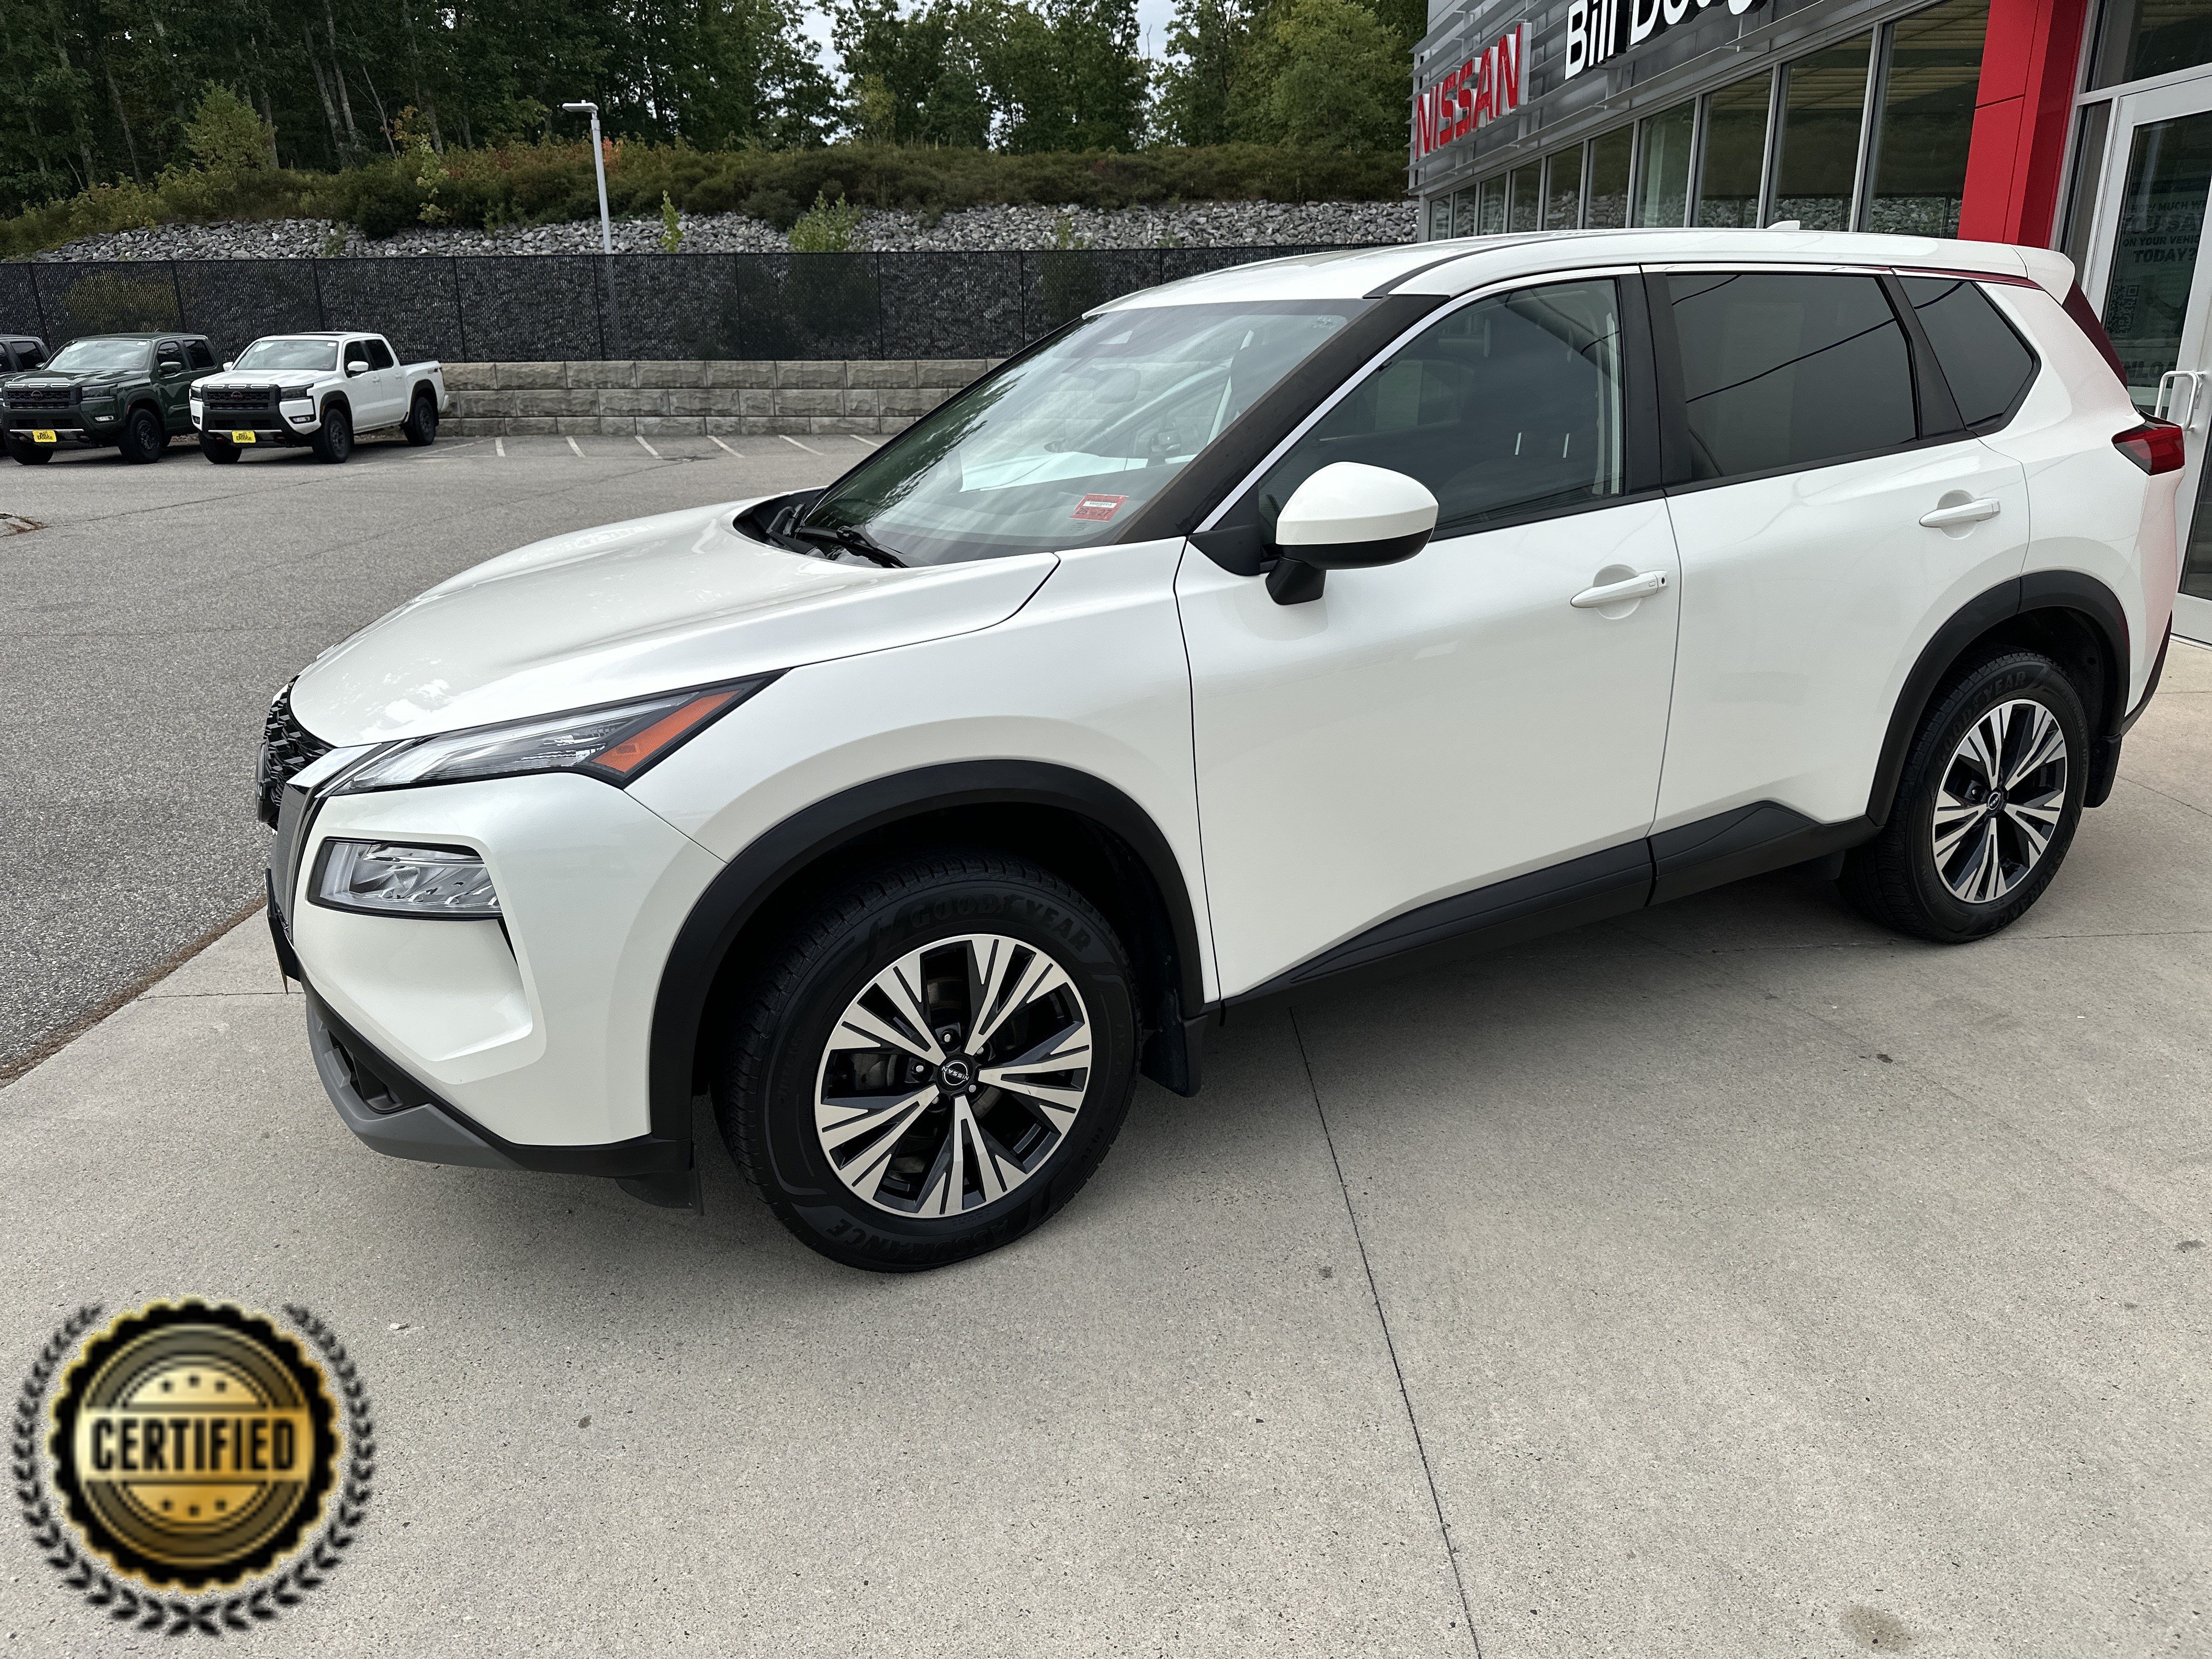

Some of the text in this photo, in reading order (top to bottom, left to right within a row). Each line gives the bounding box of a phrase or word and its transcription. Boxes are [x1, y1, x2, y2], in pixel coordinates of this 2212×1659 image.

[1564, 0, 1618, 81] Bill
[1415, 22, 1523, 160] NISSAN
[2158, 201, 2188, 211] MUCH
[2123, 238, 2137, 247] ON
[2139, 236, 2167, 246] YOUR
[2133, 247, 2197, 263] TODAY?
[941, 1066, 969, 1081] NISSAN
[825, 1217, 1009, 1262] ASSURANCE
